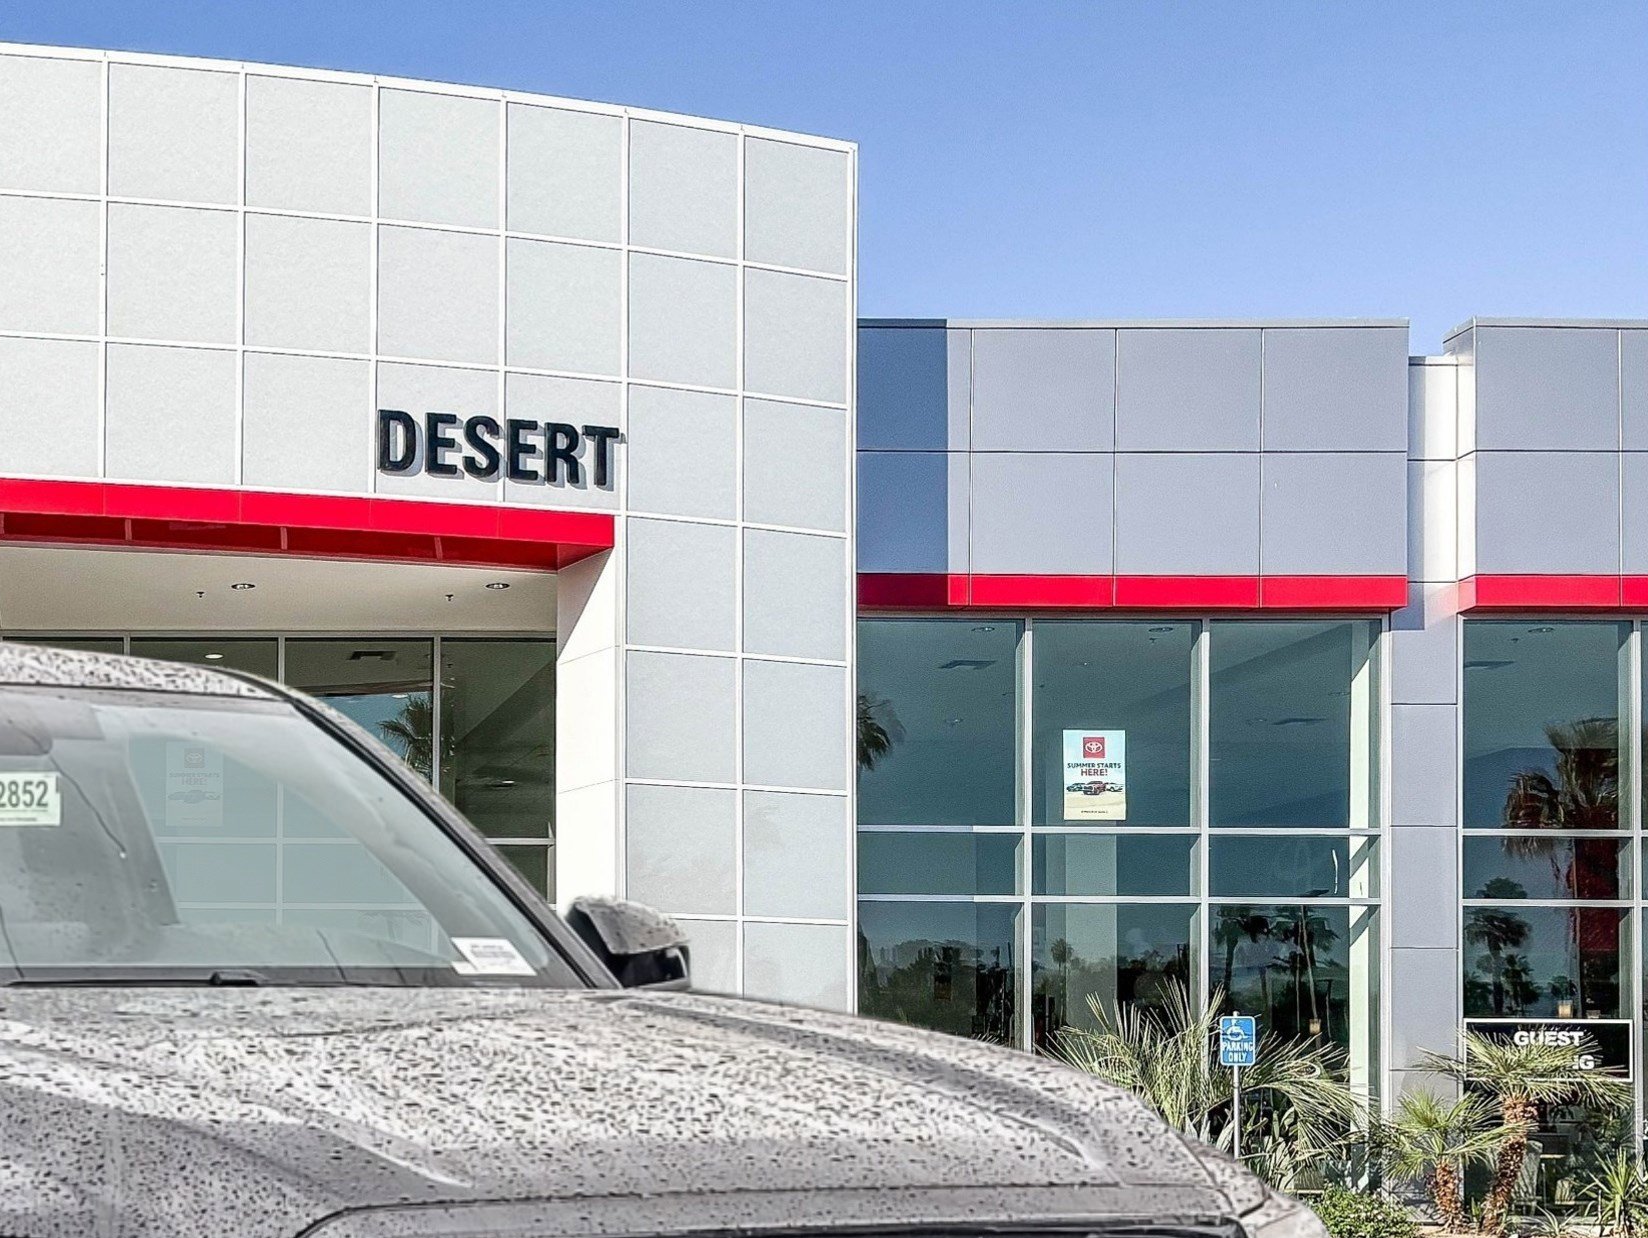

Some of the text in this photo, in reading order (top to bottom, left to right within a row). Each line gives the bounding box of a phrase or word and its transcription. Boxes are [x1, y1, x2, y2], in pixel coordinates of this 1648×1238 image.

[377, 409, 620, 486] DESERT
[1080, 769, 1108, 777] HERE!
[1513, 1030, 1584, 1047] GUEST
[1222, 1042, 1254, 1051] PARKING
[1228, 1052, 1247, 1062] ONLY
